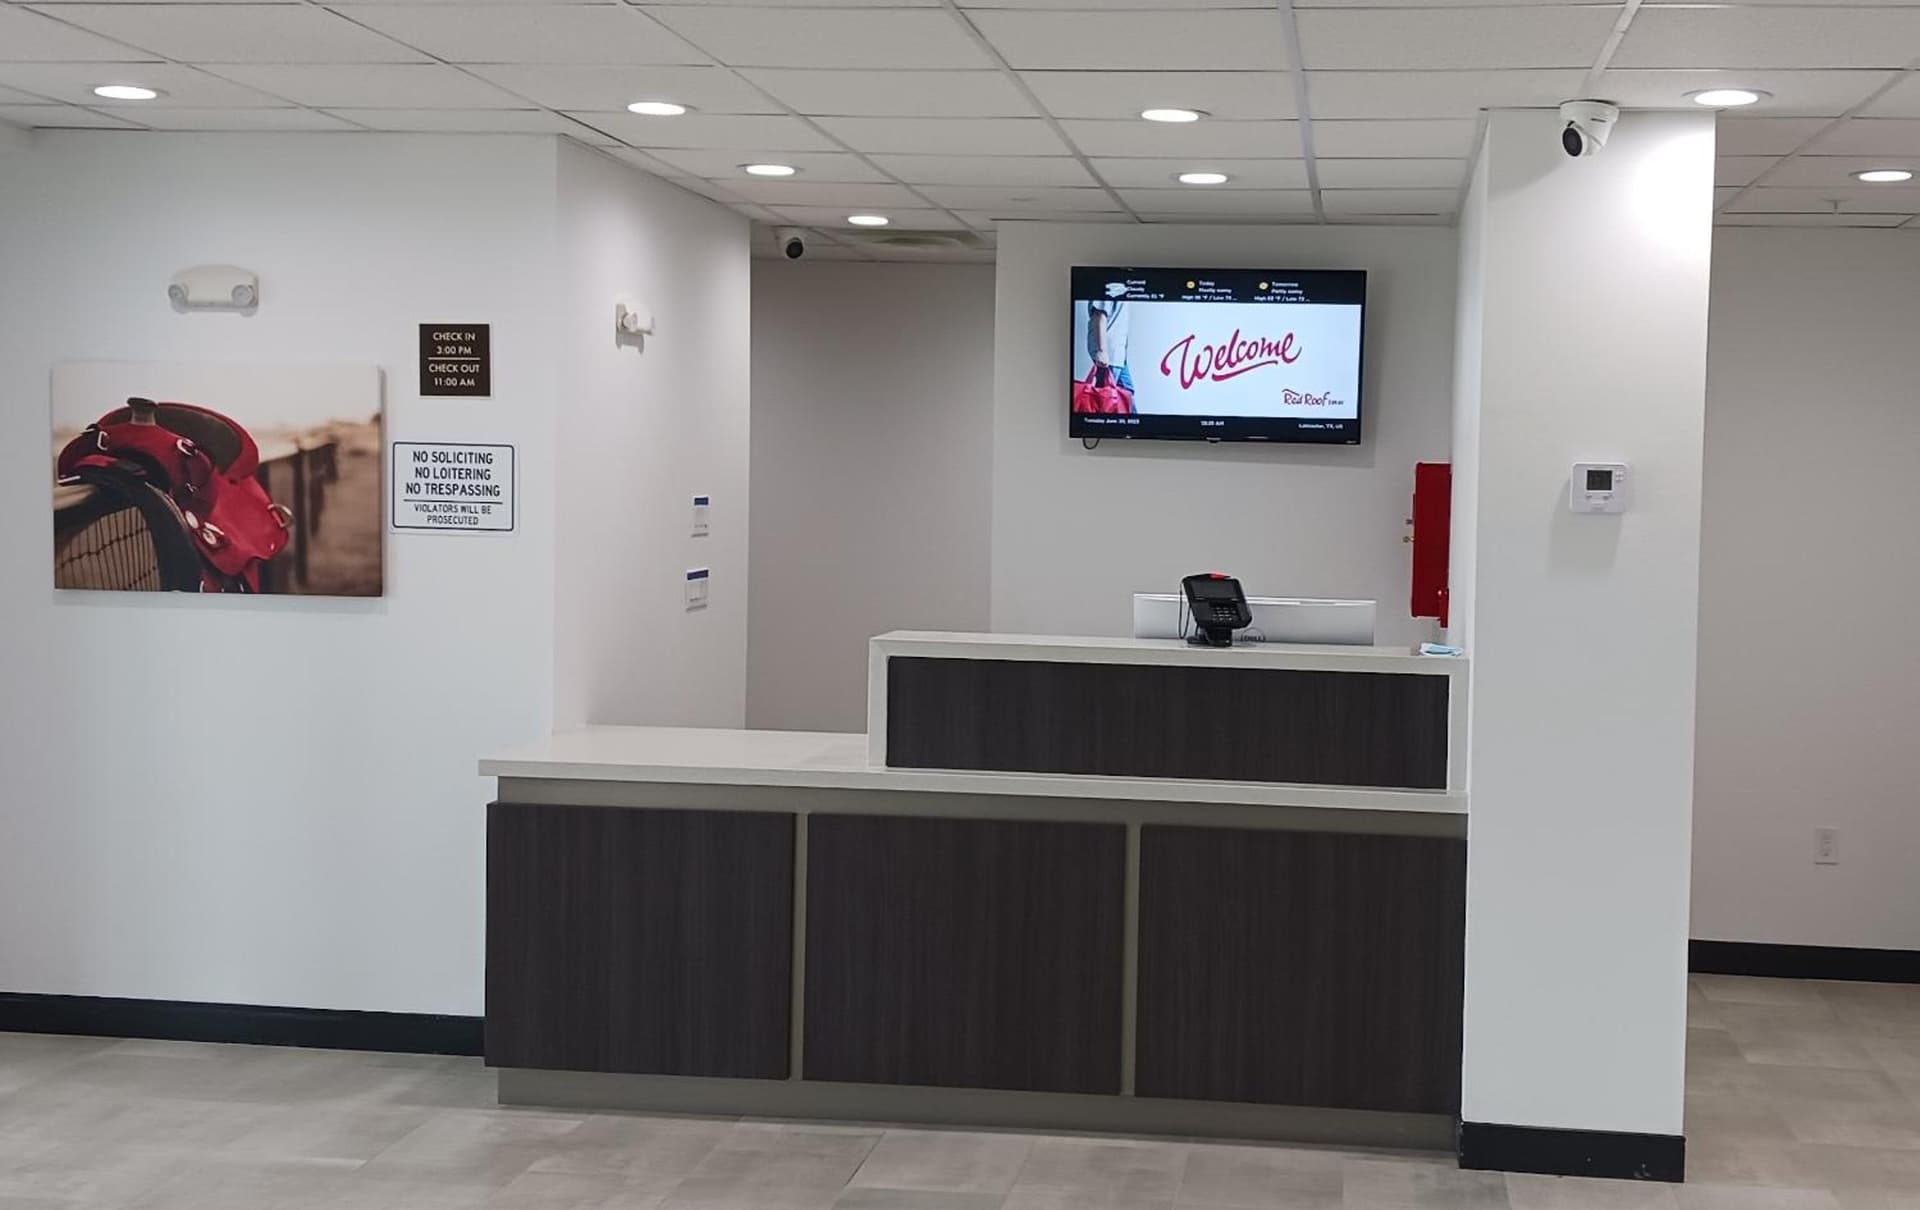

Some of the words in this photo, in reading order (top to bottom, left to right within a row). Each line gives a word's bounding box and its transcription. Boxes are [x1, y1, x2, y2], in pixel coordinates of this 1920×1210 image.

[432, 332, 462, 341] CHECK
[464, 332, 476, 341] IN
[437, 345, 457, 354] 3:00
[458, 345, 472, 354] PM
[1161, 329, 1303, 390] Welcome
[428, 364, 459, 373] CHECK
[460, 364, 480, 373] OUT
[434, 377, 458, 386] 11:00
[459, 378, 475, 386] AM
[1283, 389, 1302, 406] Red
[1304, 392, 1330, 406] Roof
[412, 450, 428, 463] NO
[431, 451, 494, 464] SOLICITING
[415, 467, 430, 479] NO
[433, 467, 491, 480] LOITERING
[406, 482, 421, 494] NO
[425, 483, 501, 496] TRESPASSING
[414, 503, 459, 513] VIOLATORS
[460, 505, 480, 514] WILL
[481, 505, 492, 514] BE
[427, 515, 479, 525] PROSECUTED
